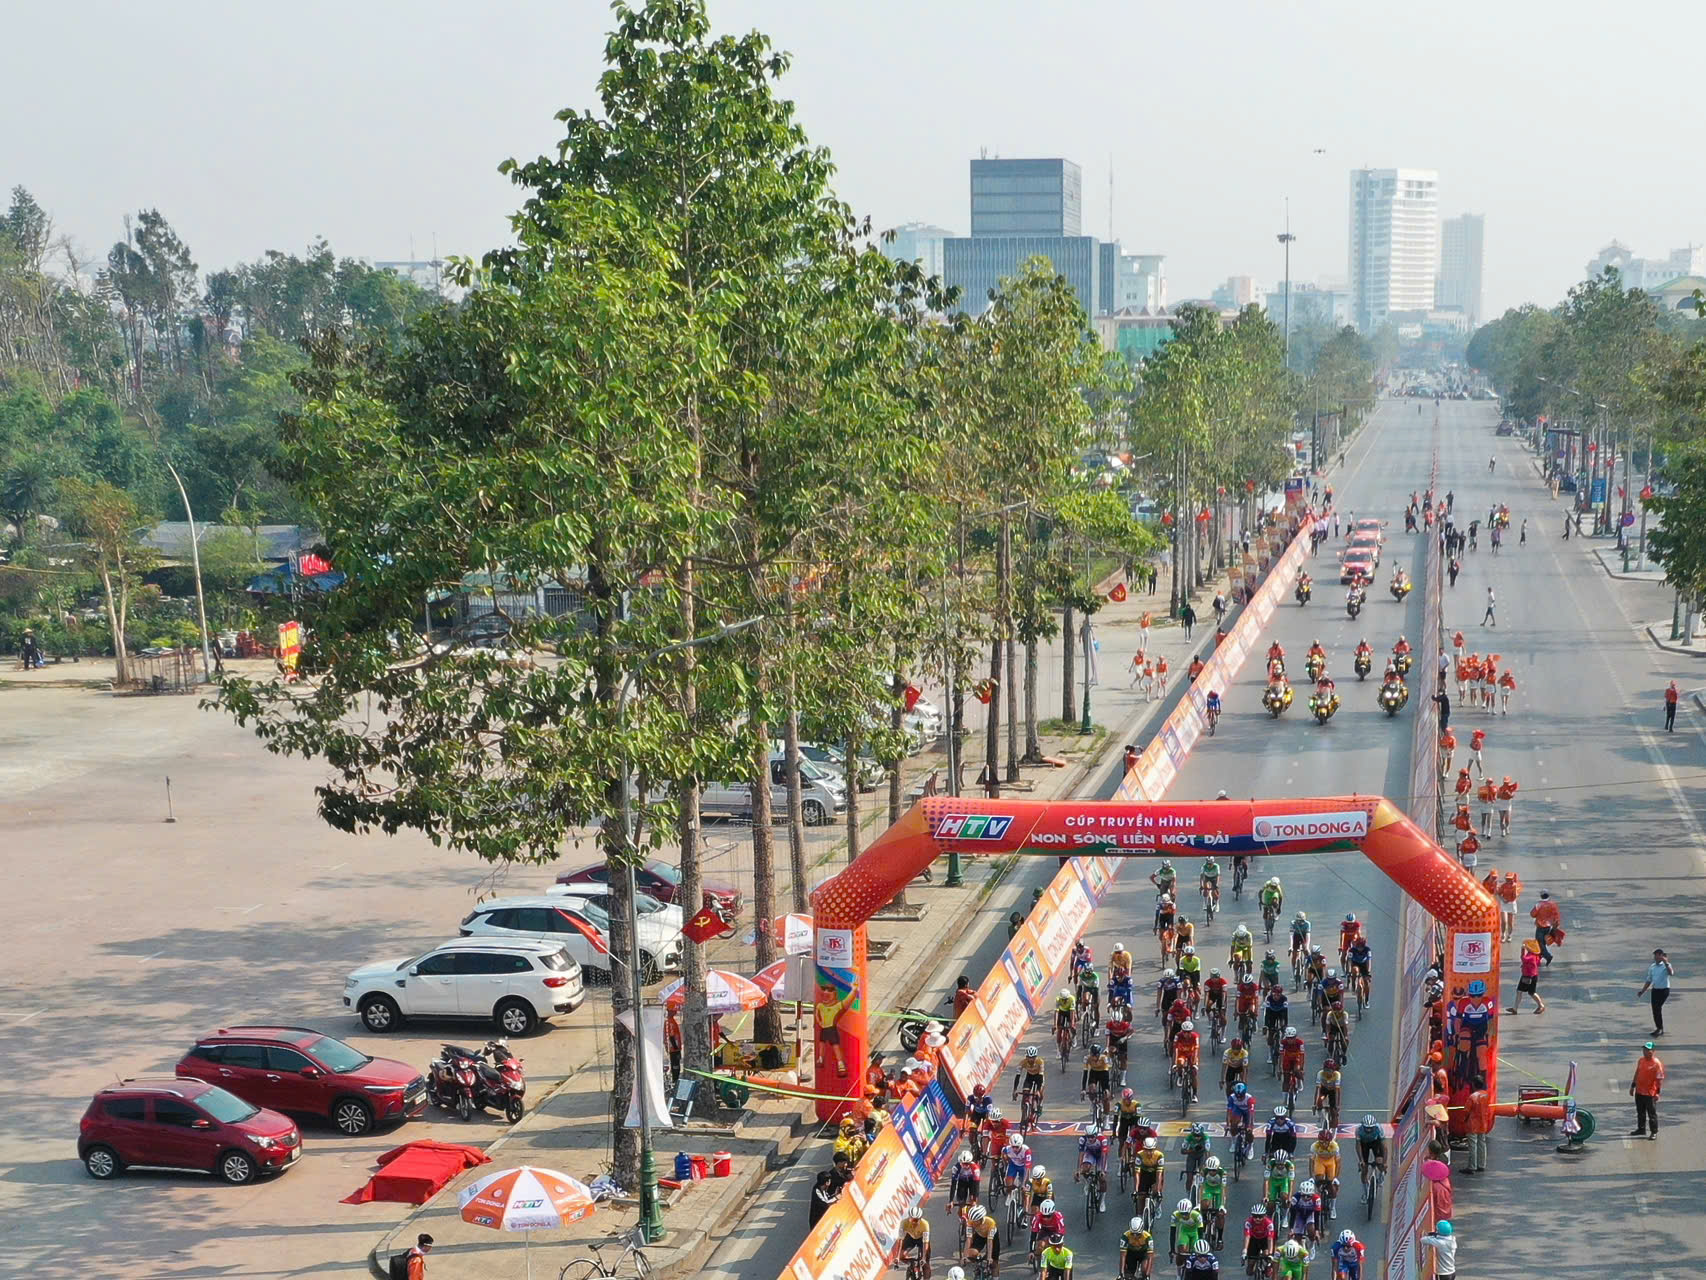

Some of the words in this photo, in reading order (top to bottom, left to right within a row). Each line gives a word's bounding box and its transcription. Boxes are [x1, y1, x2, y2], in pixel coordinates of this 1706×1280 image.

[938, 816, 1011, 837] HTV
[1065, 815, 1095, 826] CÚP
[1100, 813, 1153, 826] TRUYỀN
[1159, 815, 1195, 826] HÌNH
[1274, 823, 1304, 836] TON
[1308, 822, 1350, 835] DONG
[1353, 820, 1364, 832] A
[1031, 833, 1066, 843] NON
[1073, 829, 1117, 844] SÔNG
[1123, 830, 1155, 843] LIỀN
[1162, 832, 1197, 845] MỘT
[1204, 830, 1230, 844] DẢI
[512, 1199, 544, 1209] HTV
[879, 1200, 901, 1235] TON
[895, 1177, 916, 1216] DONG
[865, 1241, 876, 1261] A
